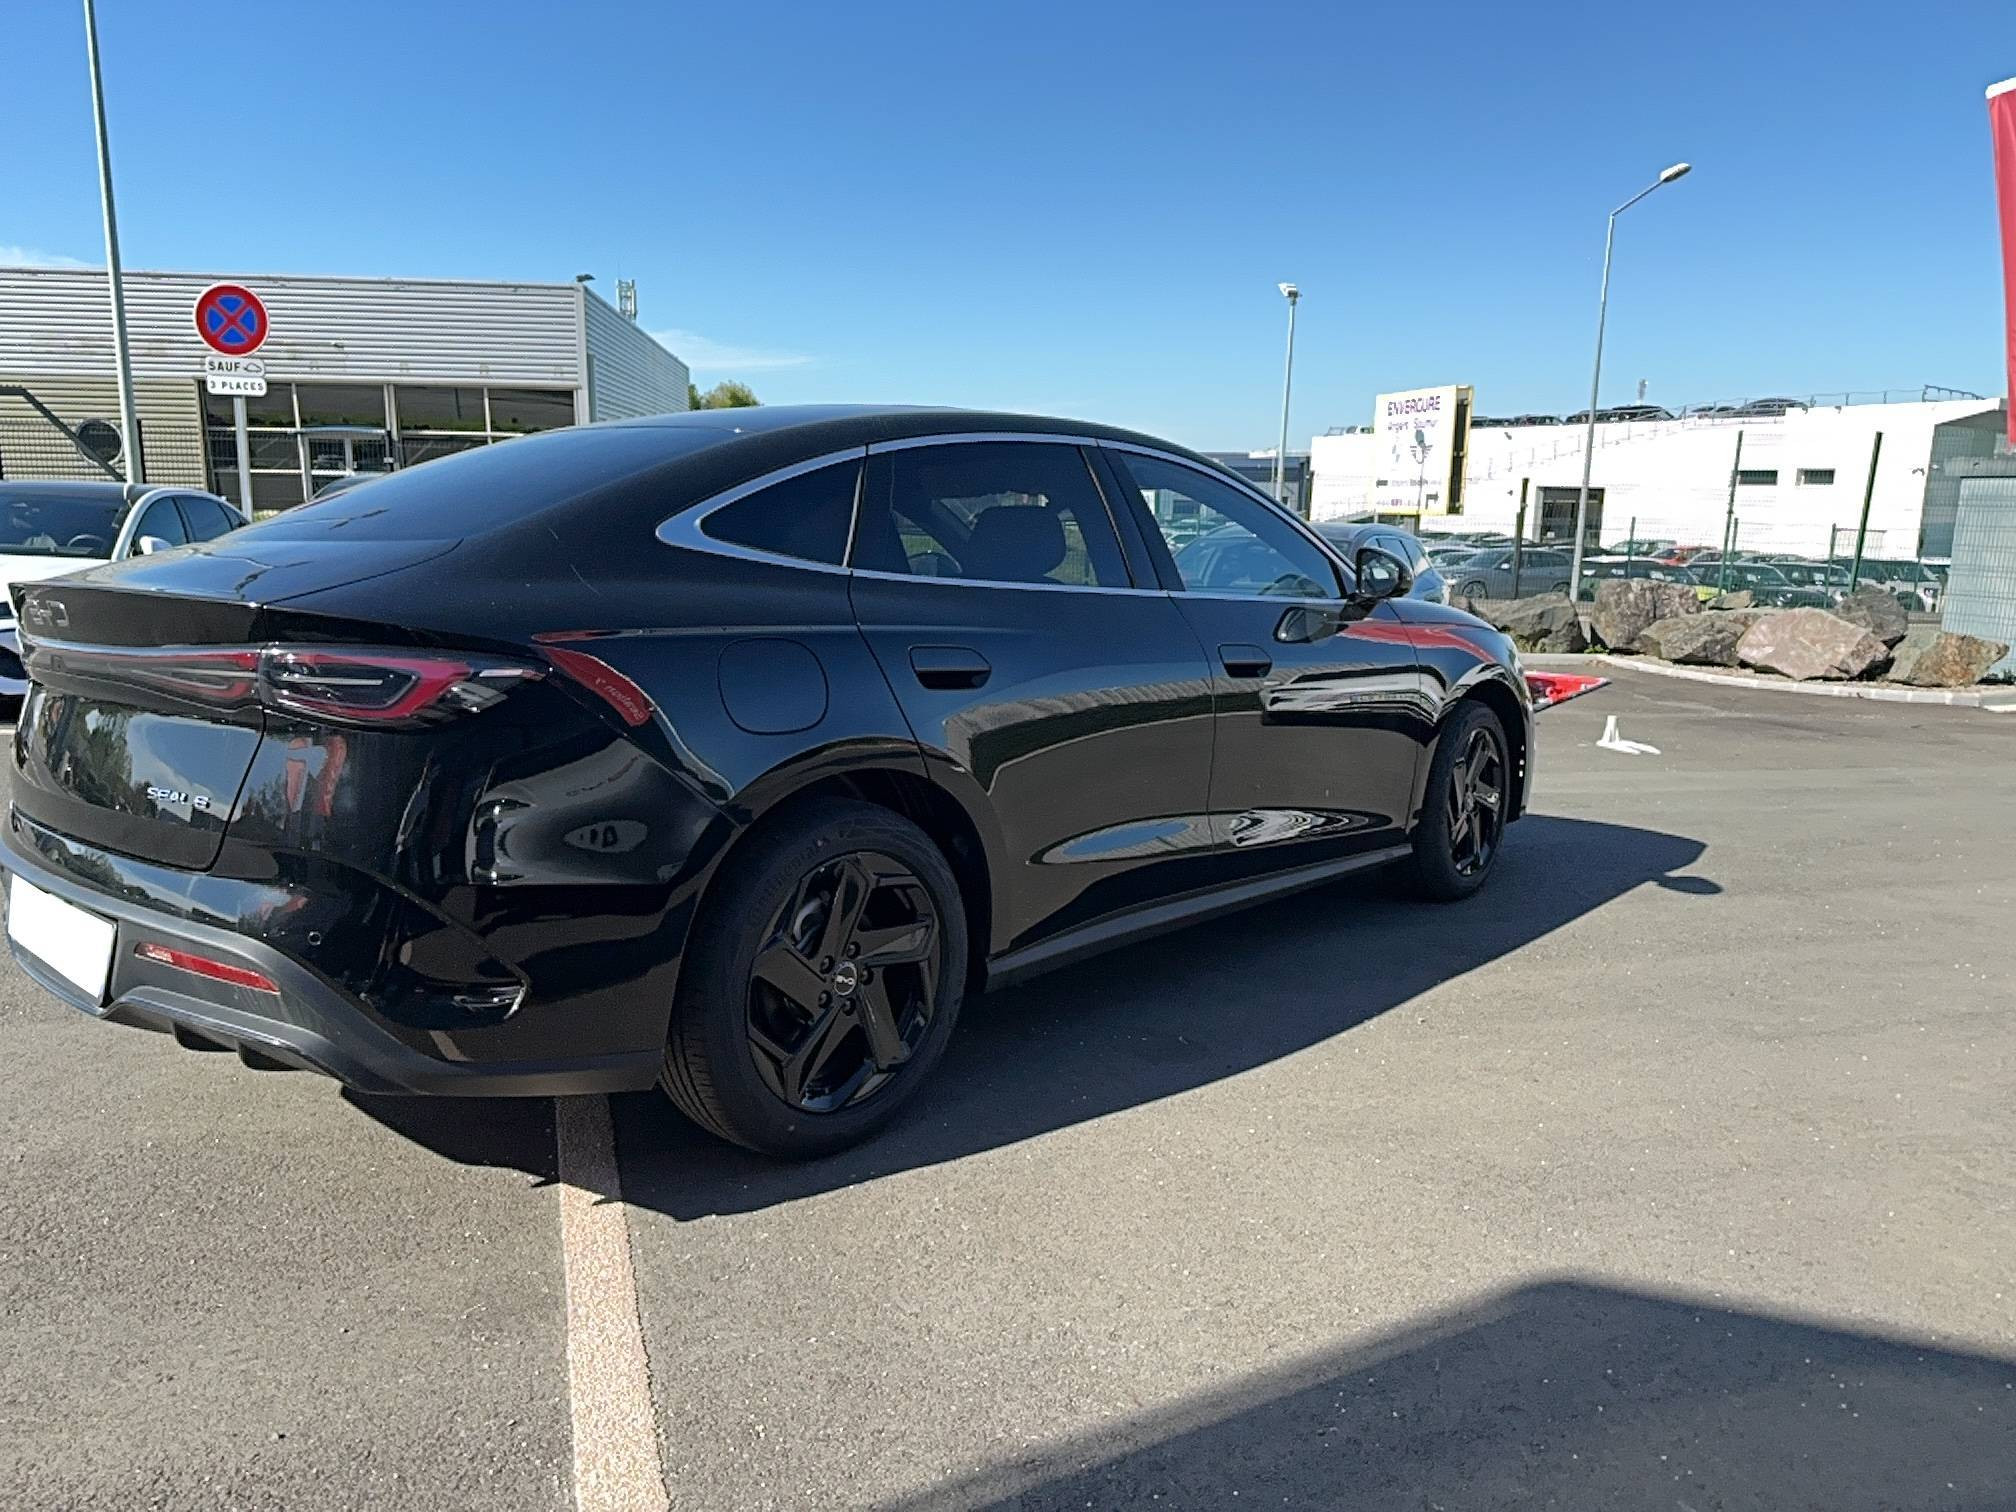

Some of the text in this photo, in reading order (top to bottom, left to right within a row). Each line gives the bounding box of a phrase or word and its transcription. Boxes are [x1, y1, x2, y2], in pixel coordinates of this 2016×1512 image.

[208, 361, 241, 372] SAUF
[210, 380, 264, 391] 3 PLACES
